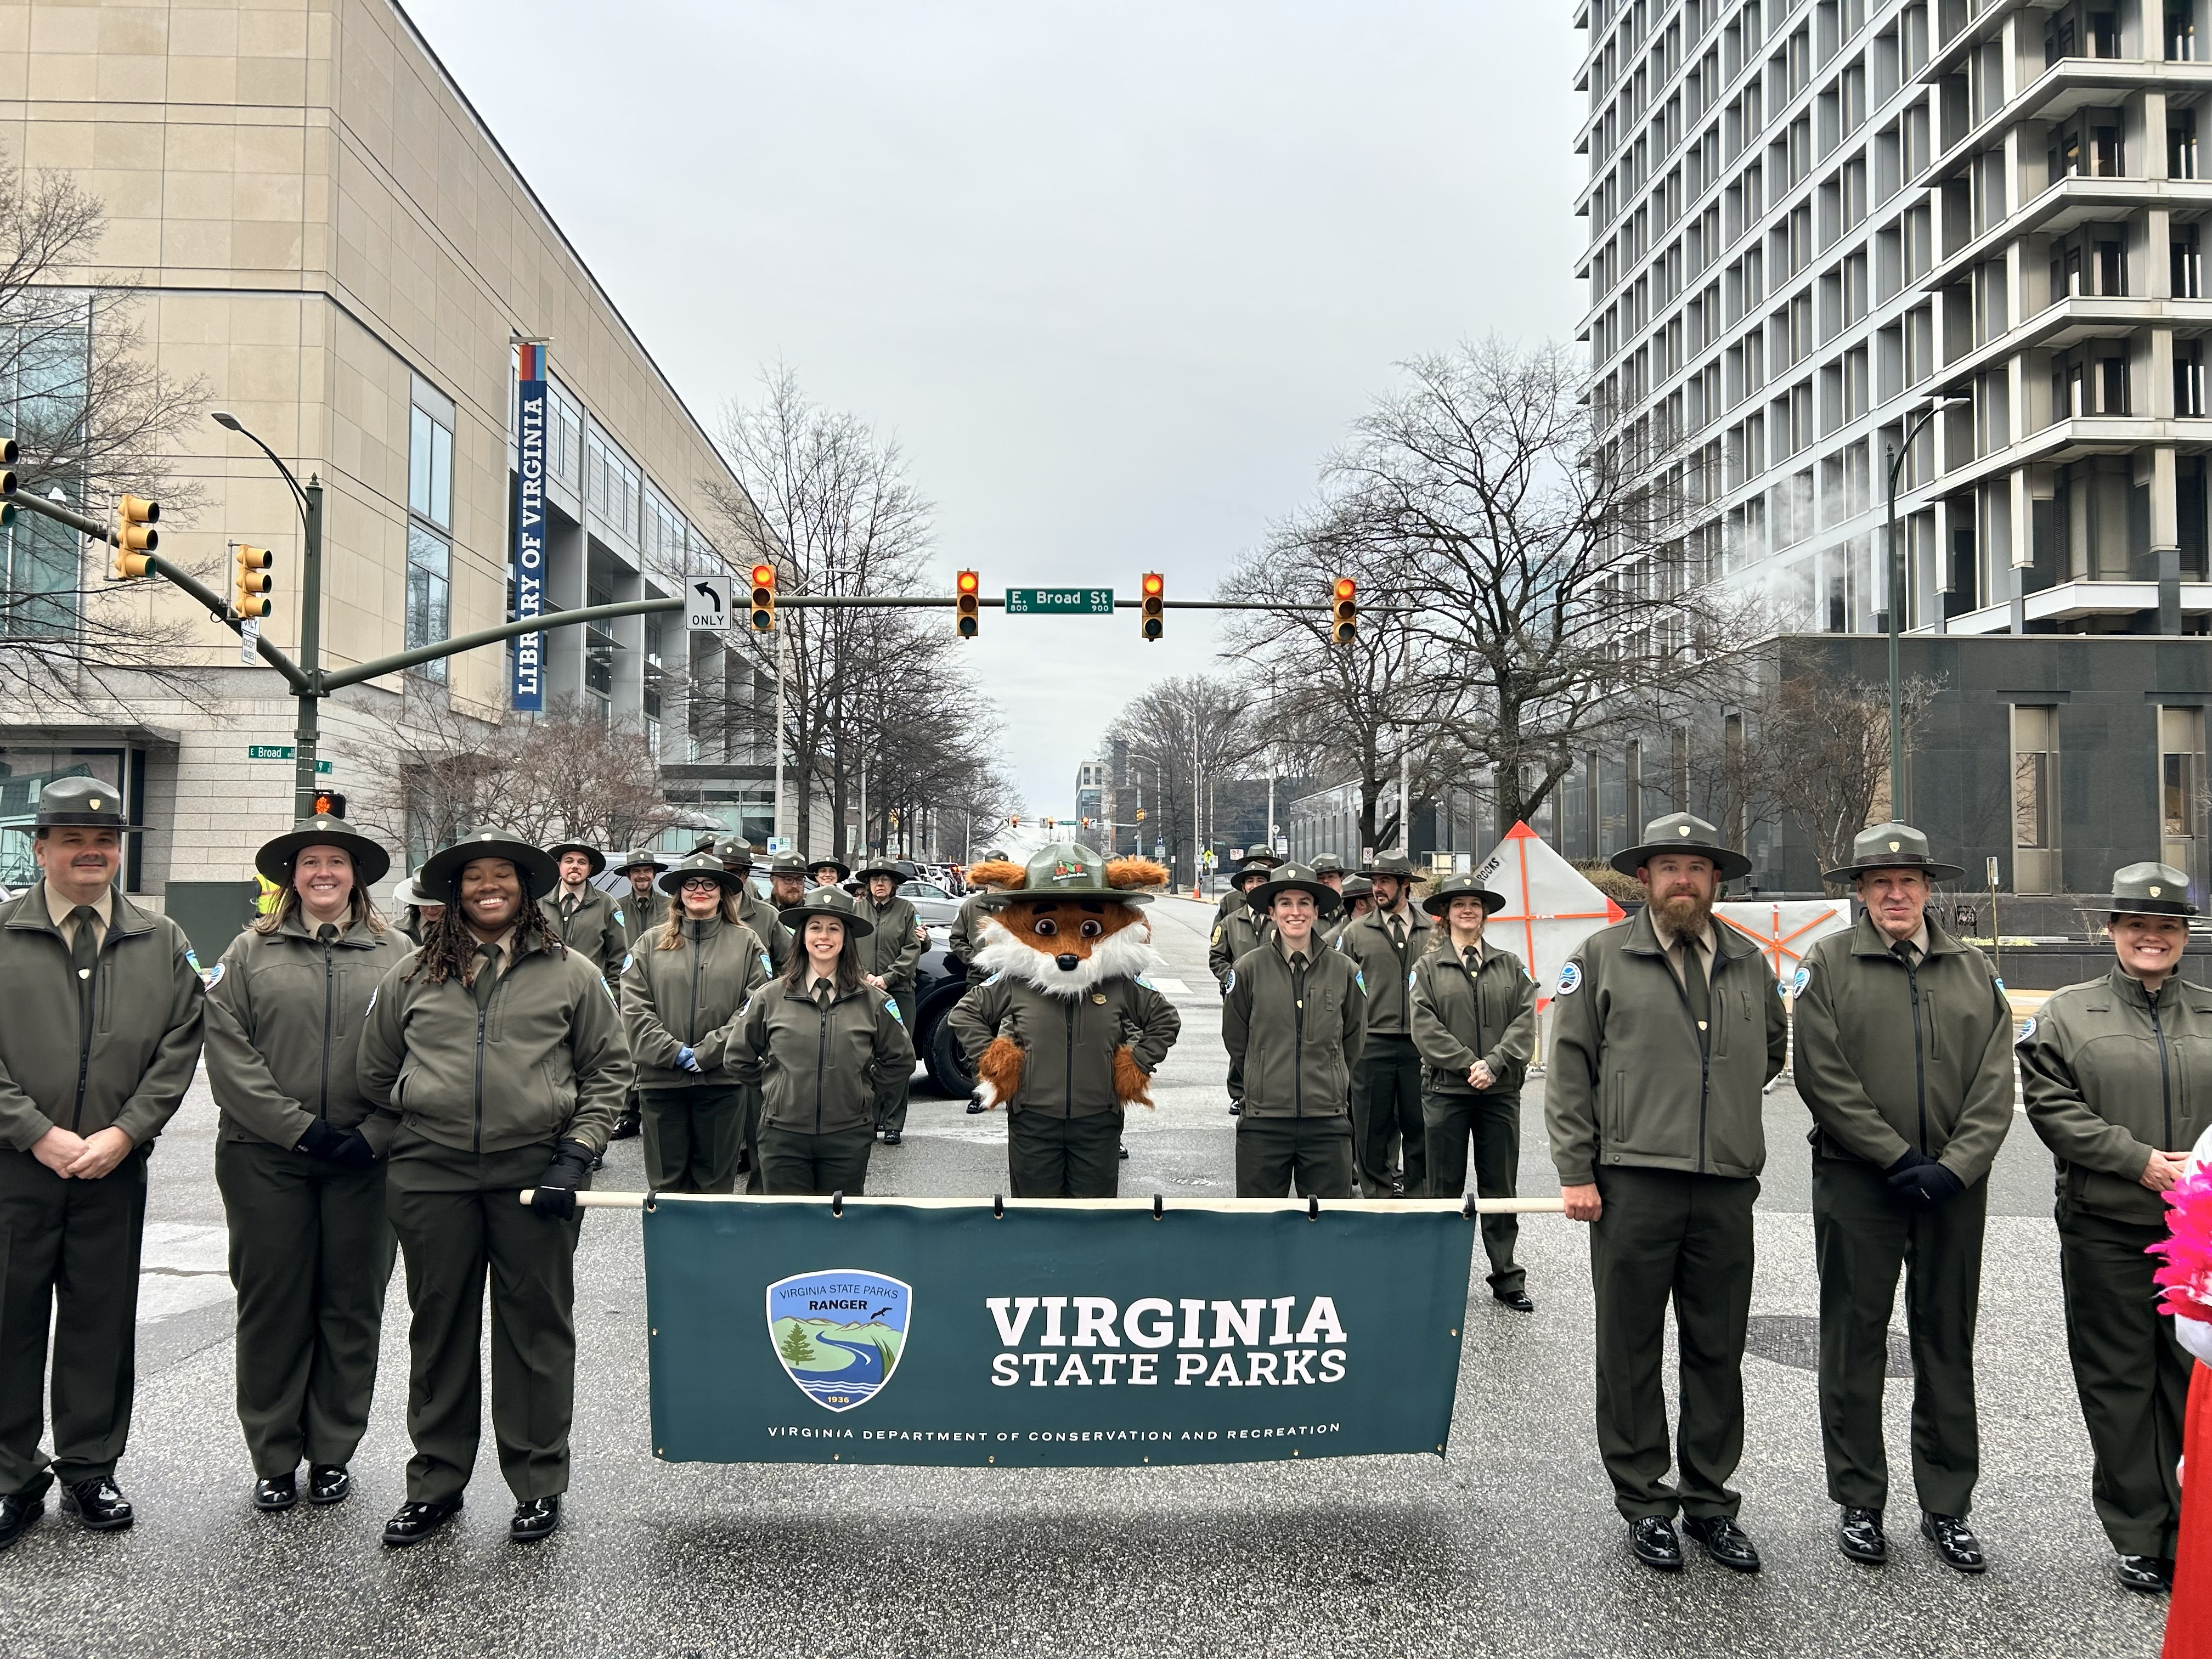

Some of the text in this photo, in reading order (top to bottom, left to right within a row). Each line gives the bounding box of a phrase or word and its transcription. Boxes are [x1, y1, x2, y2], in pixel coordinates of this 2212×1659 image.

[522, 397, 542, 527] VIRGINIA
[522, 532, 540, 568] OF
[1012, 591, 1107, 604] E. Broad St
[692, 615, 724, 625] ONLY
[258, 747, 281, 758] Broad
[779, 1284, 899, 1299] VIRGINIA STATE PARKS
[809, 1300, 867, 1310] RANGER
[986, 1296, 1347, 1348] VIRGINIA
[991, 1349, 1347, 1387] STATE PARKS
[768, 1423, 1340, 1442] VIRGINIA DEPARTMENT OF CONSERVATION AND RECREATION
